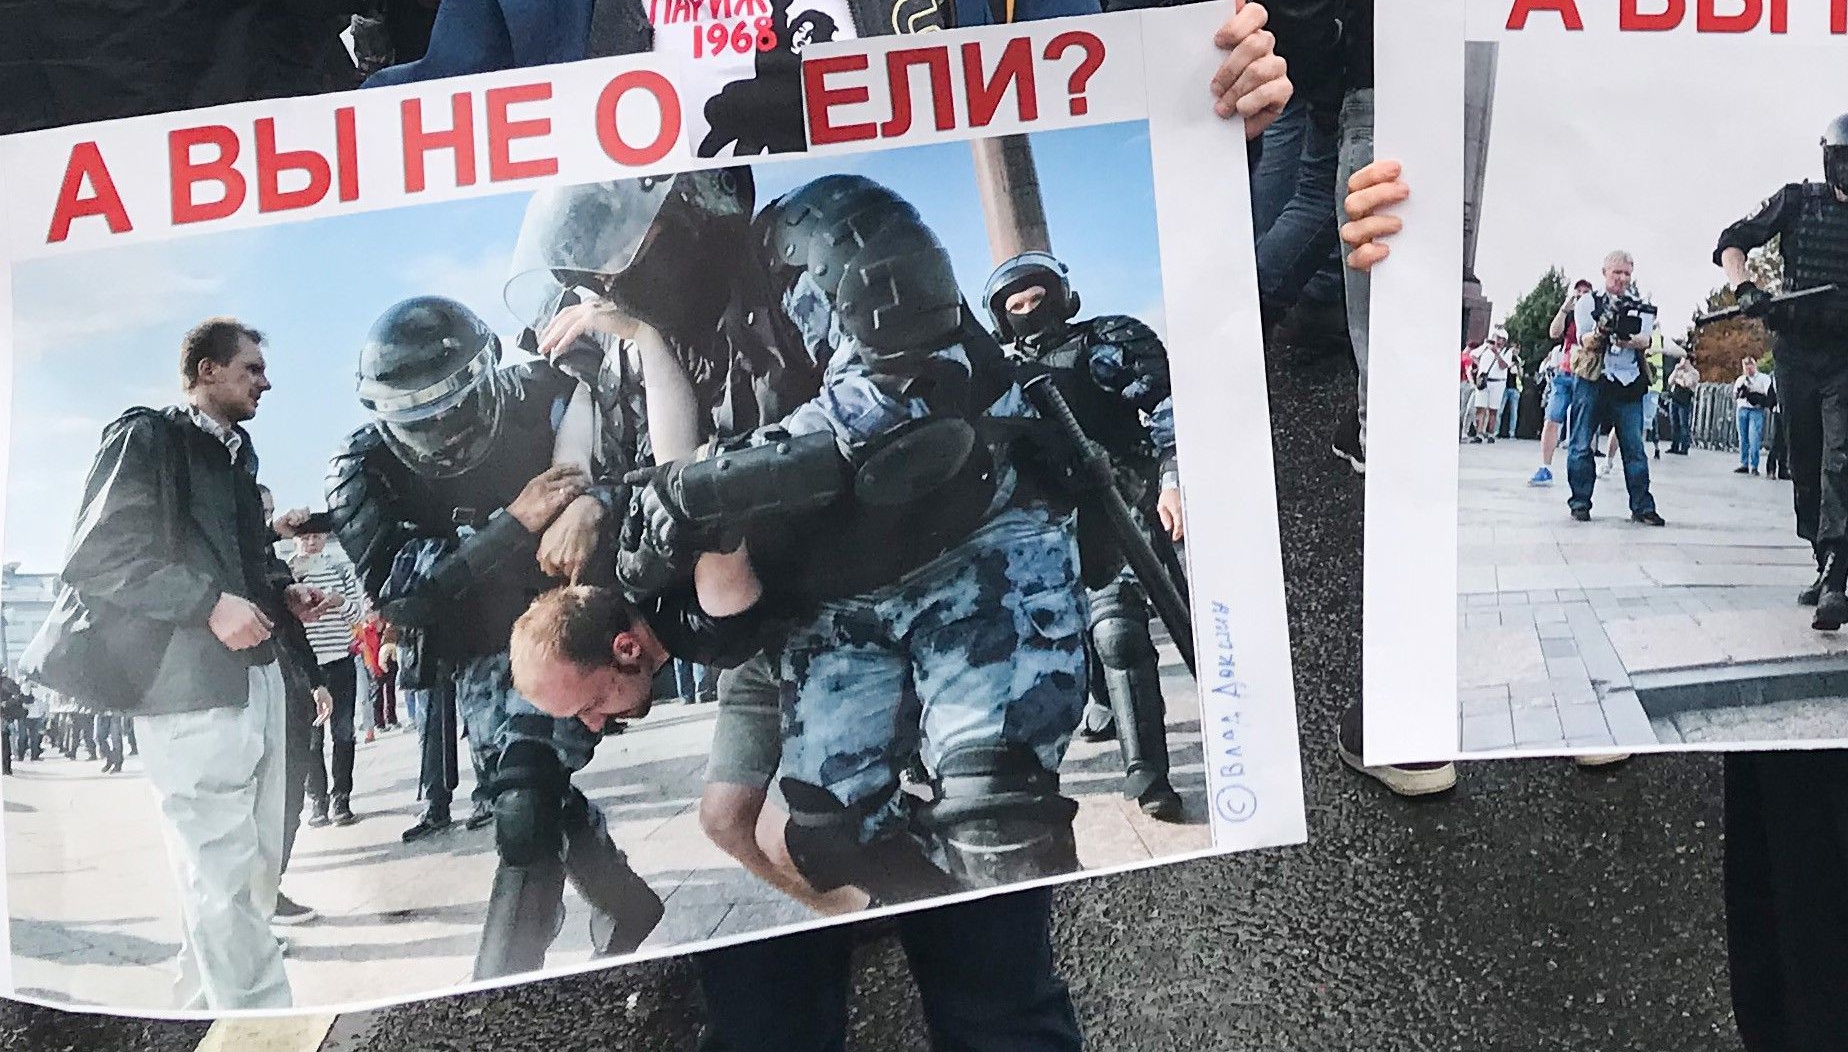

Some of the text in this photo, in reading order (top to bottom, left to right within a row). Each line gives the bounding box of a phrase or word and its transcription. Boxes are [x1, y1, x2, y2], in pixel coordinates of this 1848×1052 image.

[693, 16, 778, 59] 1968
[804, 31, 1105, 145] ЕЛИ?
[48, 70, 682, 243] А ВЫ НЕ О
